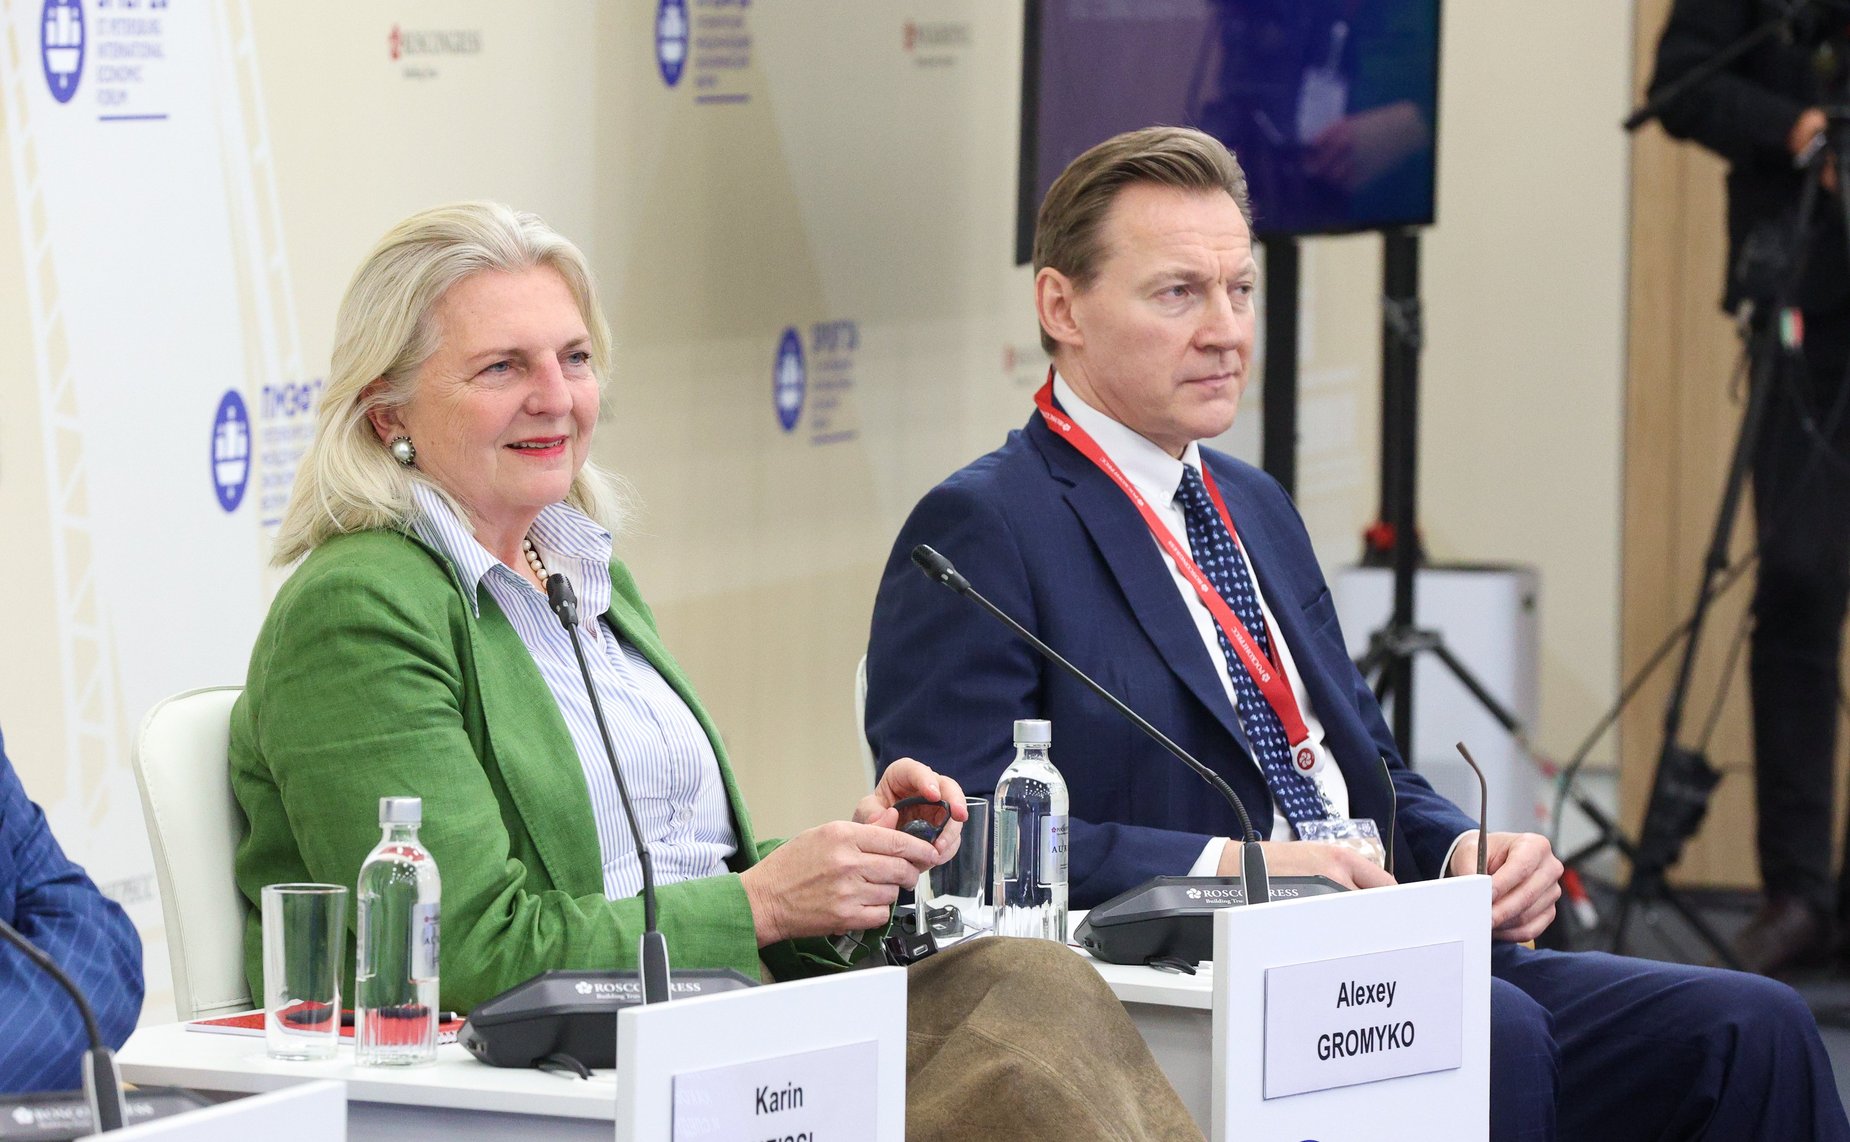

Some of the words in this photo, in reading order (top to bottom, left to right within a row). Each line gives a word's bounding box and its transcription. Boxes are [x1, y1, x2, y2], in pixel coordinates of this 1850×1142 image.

[1229, 625, 1266, 675] РОСКОНГРЕСС
[1336, 980, 1397, 1009] Alexey
[1317, 1020, 1415, 1061] GROMYKO
[755, 1081, 803, 1116] Karin
